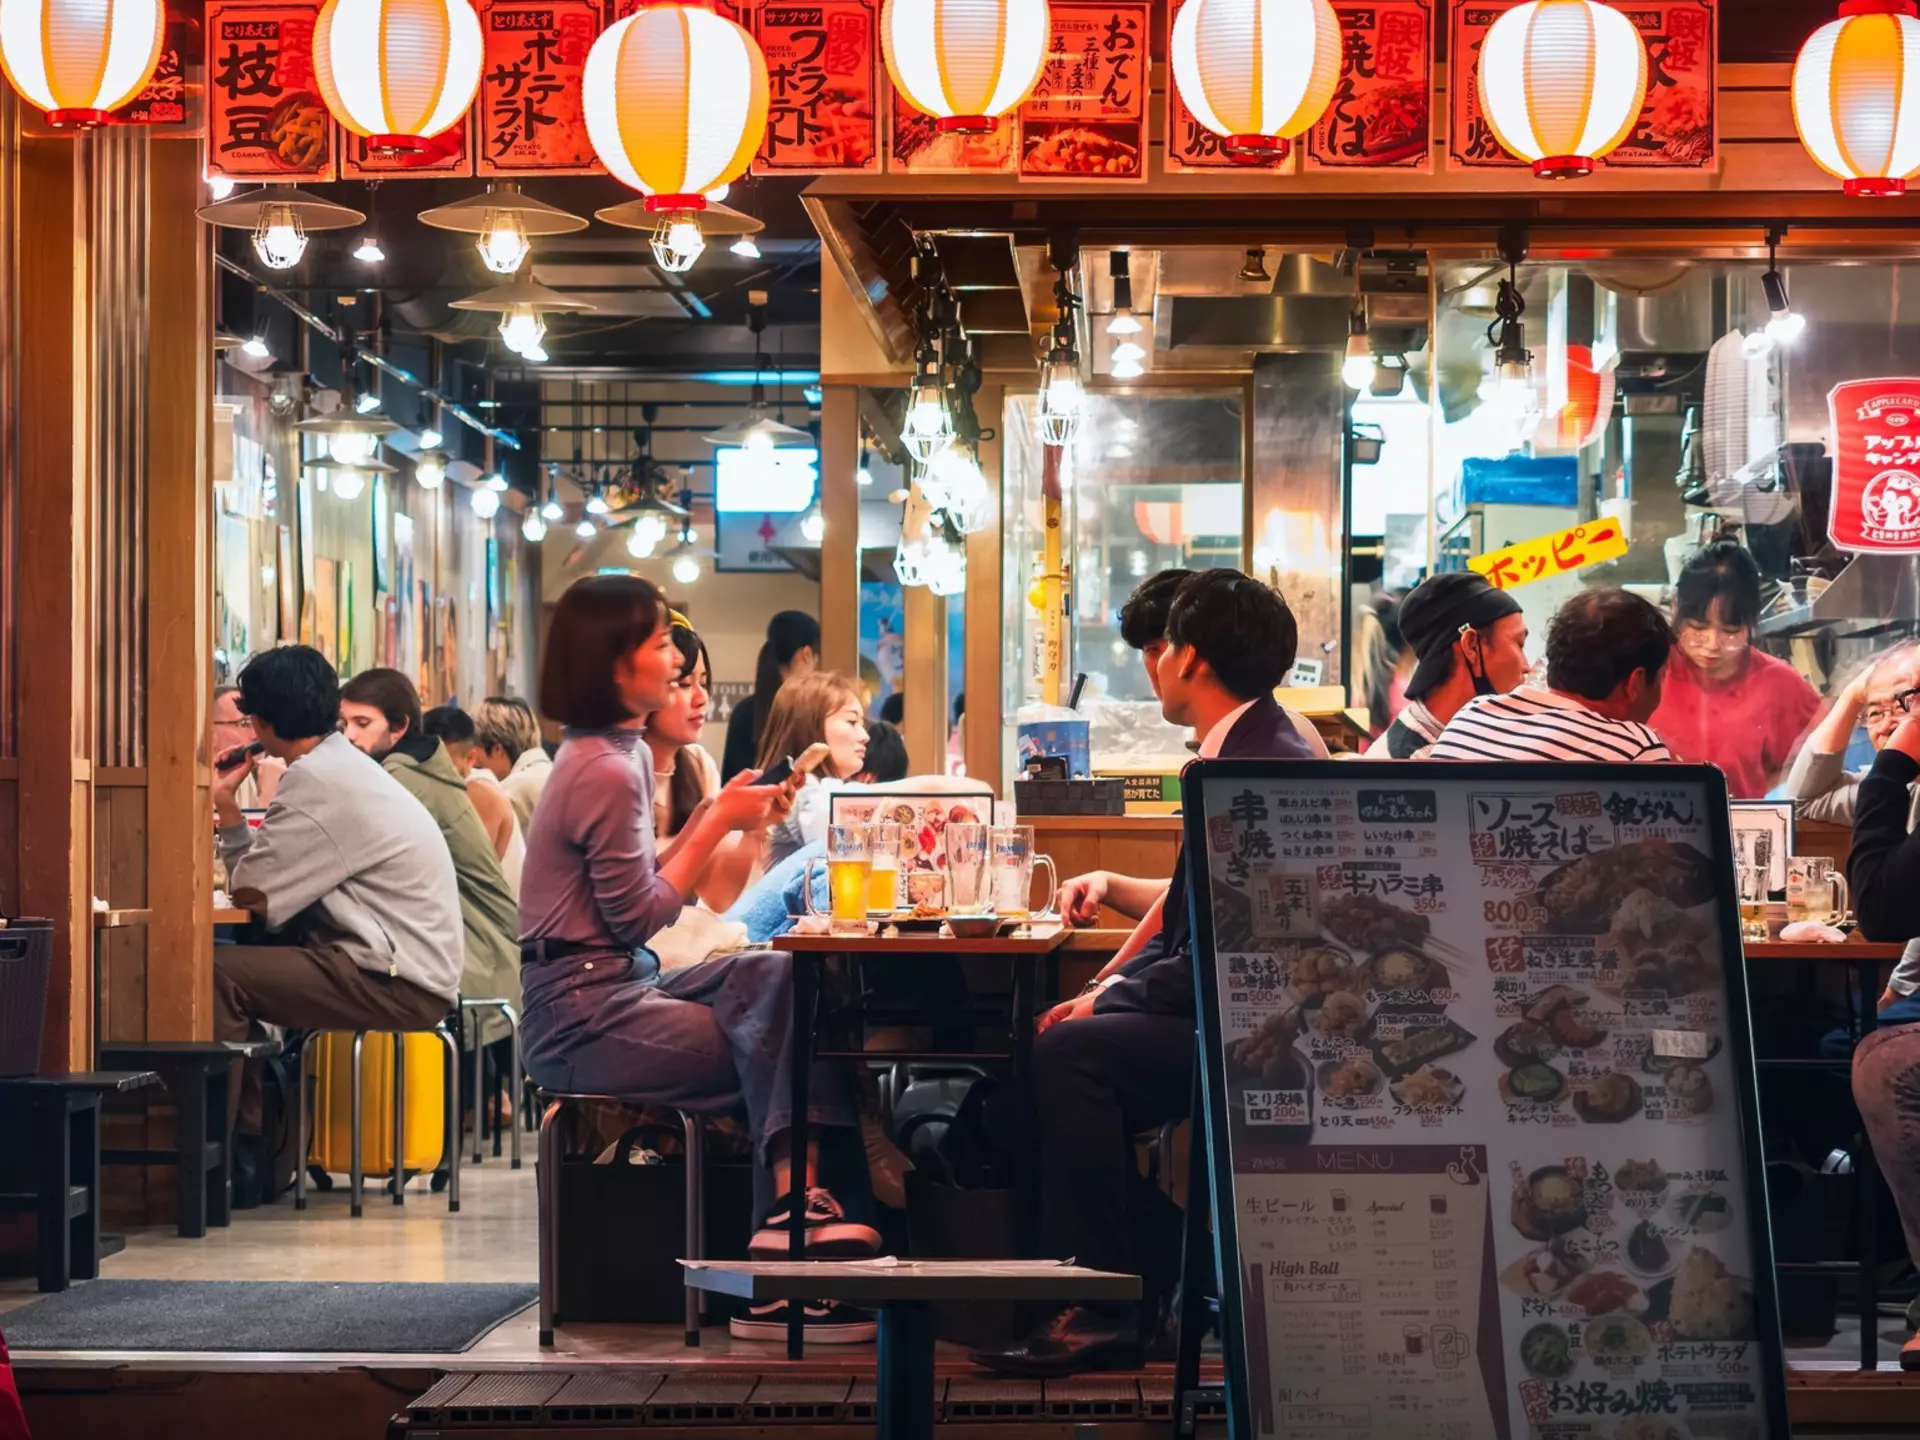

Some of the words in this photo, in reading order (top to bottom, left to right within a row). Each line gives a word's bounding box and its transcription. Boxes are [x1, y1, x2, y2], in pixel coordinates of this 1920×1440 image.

[223, 24, 279, 37] とりあえず
[494, 13, 552, 28] とりあえず
[765, 11, 821, 24] サックサク
[1100, 13, 1138, 107] おでん
[215, 42, 283, 152] 枝豆
[520, 29, 565, 142] ポテト
[789, 29, 828, 146] フライド
[1331, 31, 1376, 158] 焼そば
[1466, 76, 1474, 121] TAKOYAKI
[486, 62, 531, 158] サラダ
[768, 62, 800, 158] ポテト
[1485, 528, 1614, 589] ホッピー
[1477, 798, 1562, 832] ソース
[1226, 788, 1276, 888] 串焼き
[1500, 825, 1595, 861] 焼そば
[1342, 872, 1444, 896] 牛ハラミ串
[1483, 901, 1548, 923] 800円
[1320, 1115, 1354, 1127] とり天
[1392, 1105, 1464, 1116] フライドポテト
[1506, 1103, 1561, 1114] アンチョビ
[1506, 1113, 1550, 1125] キャベツ
[1315, 1151, 1395, 1170] MENU
[1245, 1197, 1317, 1215] 生ビール
[1269, 1260, 1305, 1277] High
[1309, 1260, 1341, 1275] Ball
[1656, 1342, 1749, 1362] ポテトサラダ
[1547, 1378, 1678, 1416] お好み焼
